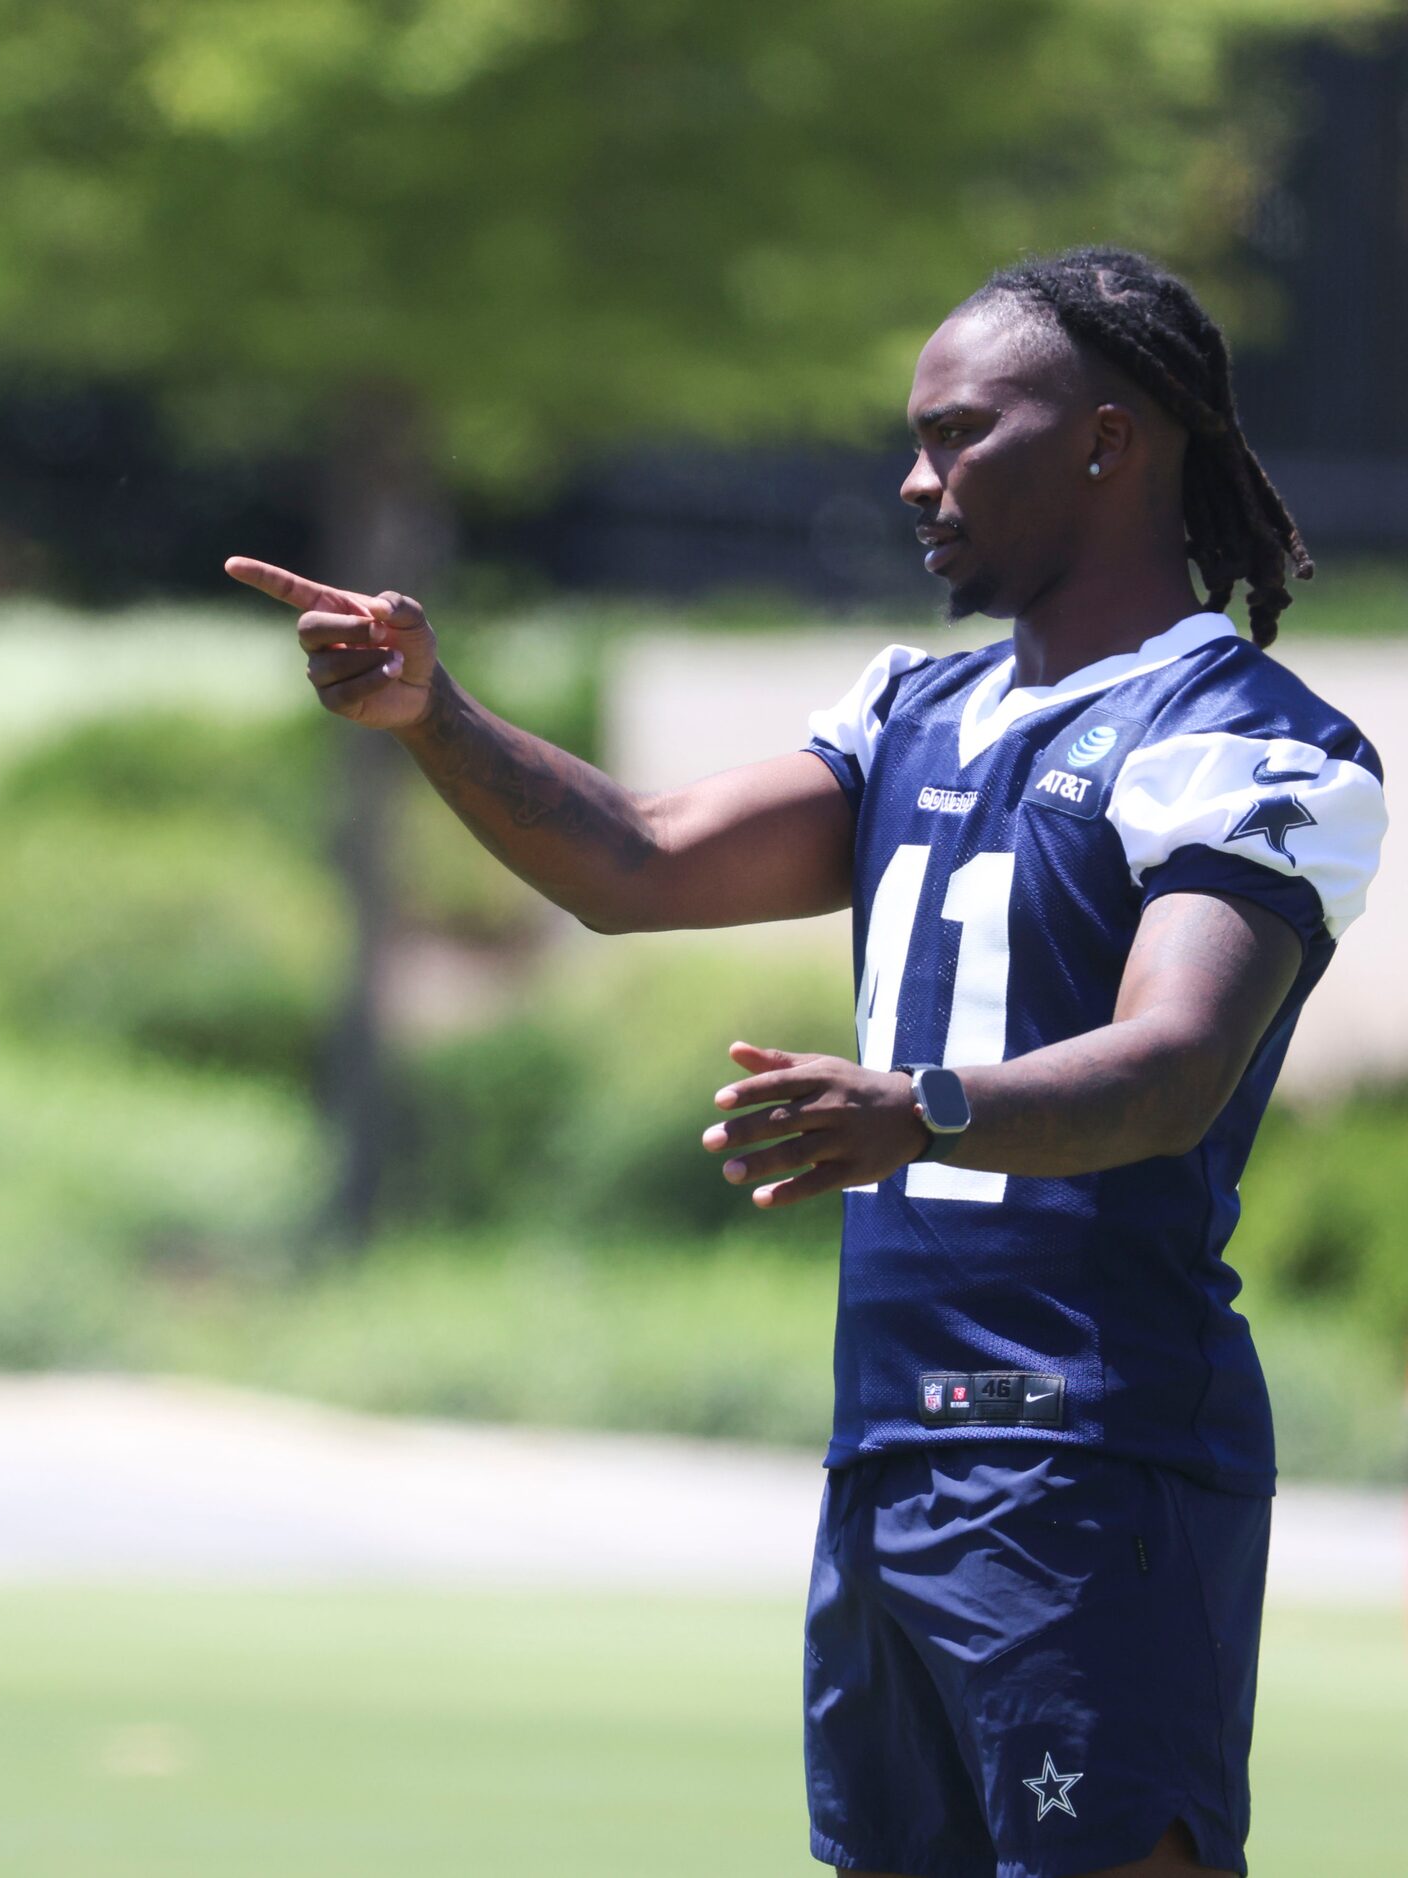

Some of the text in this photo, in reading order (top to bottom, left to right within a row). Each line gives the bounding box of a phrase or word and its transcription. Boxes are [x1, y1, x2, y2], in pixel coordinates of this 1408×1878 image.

[917, 787, 979, 813] COWBOY
[1035, 769, 1093, 803] AT&T
[843, 844, 1016, 1203] 41
[981, 1379, 1012, 1398] 46
